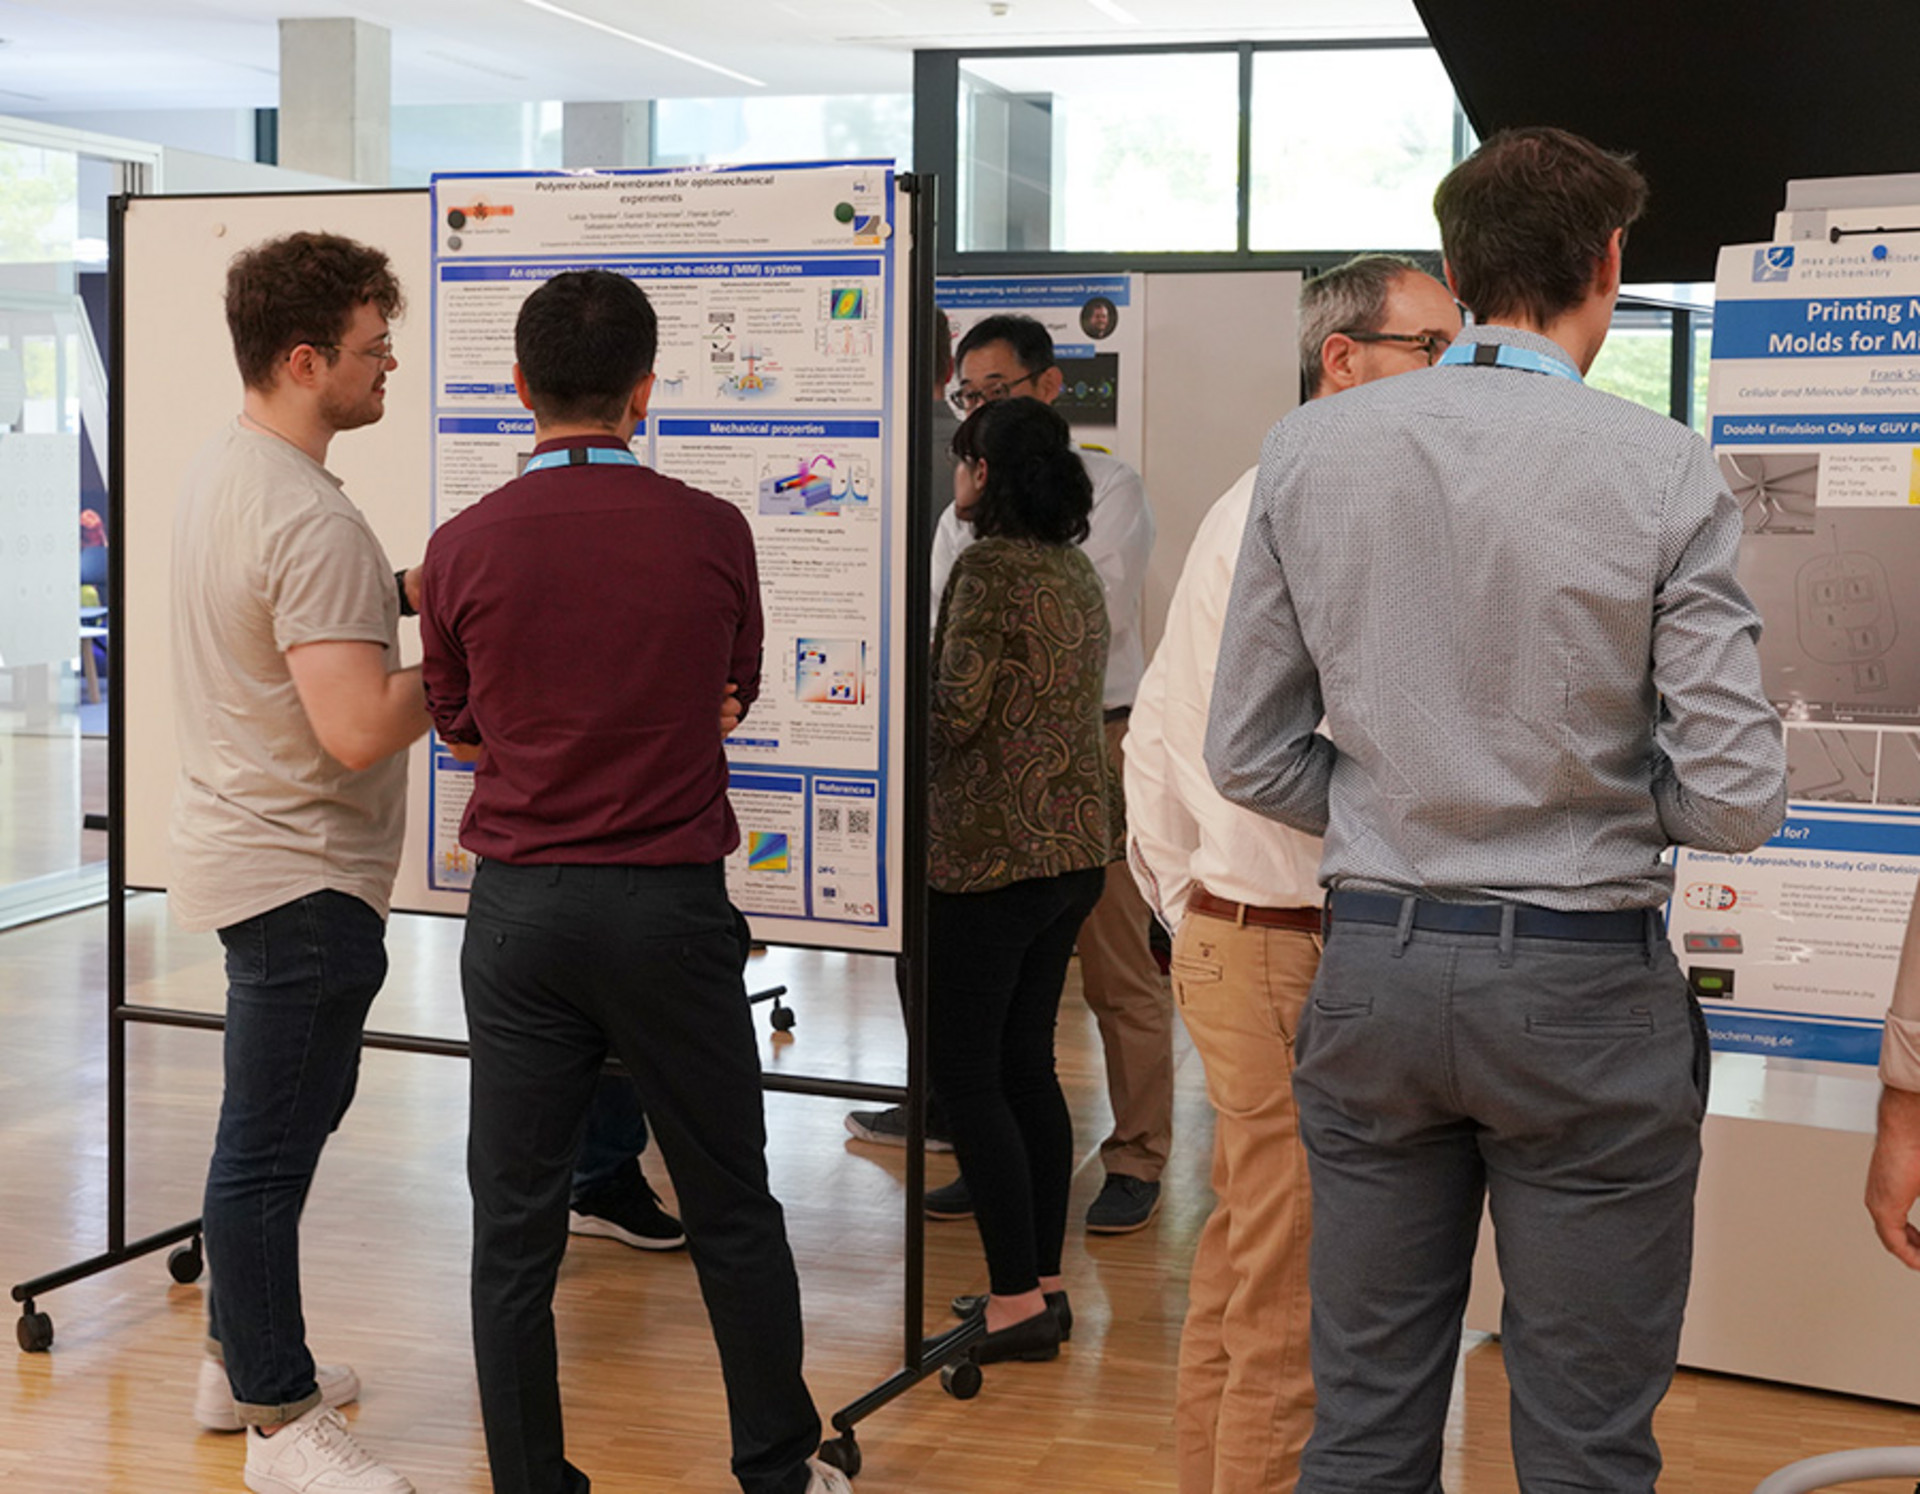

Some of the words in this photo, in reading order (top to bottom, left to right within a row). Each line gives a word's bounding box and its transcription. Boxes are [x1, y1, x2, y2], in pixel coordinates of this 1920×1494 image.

[535, 181, 611, 193] Polymer-based
[612, 179, 671, 190] membranes
[673, 178, 689, 188] for
[690, 175, 774, 189] optomechanical
[619, 193, 683, 205] experiments
[1828, 254, 1866, 266] planck
[509, 267, 523, 278] An
[763, 264, 803, 277] system
[1801, 269, 1814, 279] of
[1815, 267, 1891, 279] biochemistry
[959, 285, 1004, 296] engineering
[1006, 285, 1021, 293] and
[1022, 285, 1048, 293] cancer
[1050, 284, 1085, 293] research
[1807, 299, 1902, 324] Printing
[1768, 331, 1843, 353] Molds
[1850, 329, 1885, 351] for
[1870, 368, 1903, 381] Frank
[1738, 387, 1778, 398] Cellular
[1780, 386, 1801, 397] and
[1804, 386, 1858, 397] Molecular
[496, 420, 534, 433] Optical
[710, 422, 769, 434] Mechanical
[771, 423, 825, 436] properties
[1722, 423, 1766, 436] Double
[1769, 422, 1825, 435] Emulsion
[1828, 421, 1856, 437] Chip
[1858, 421, 1877, 434] for
[1879, 421, 1908, 434] GUV
[818, 782, 873, 796] References
[1783, 826, 1811, 840] for?
[1687, 852, 1744, 866] Bottom-Up
[1746, 855, 1807, 868] Approaches
[1809, 859, 1821, 869] to
[1823, 859, 1853, 872] Study
[1856, 861, 1877, 872] Cell
